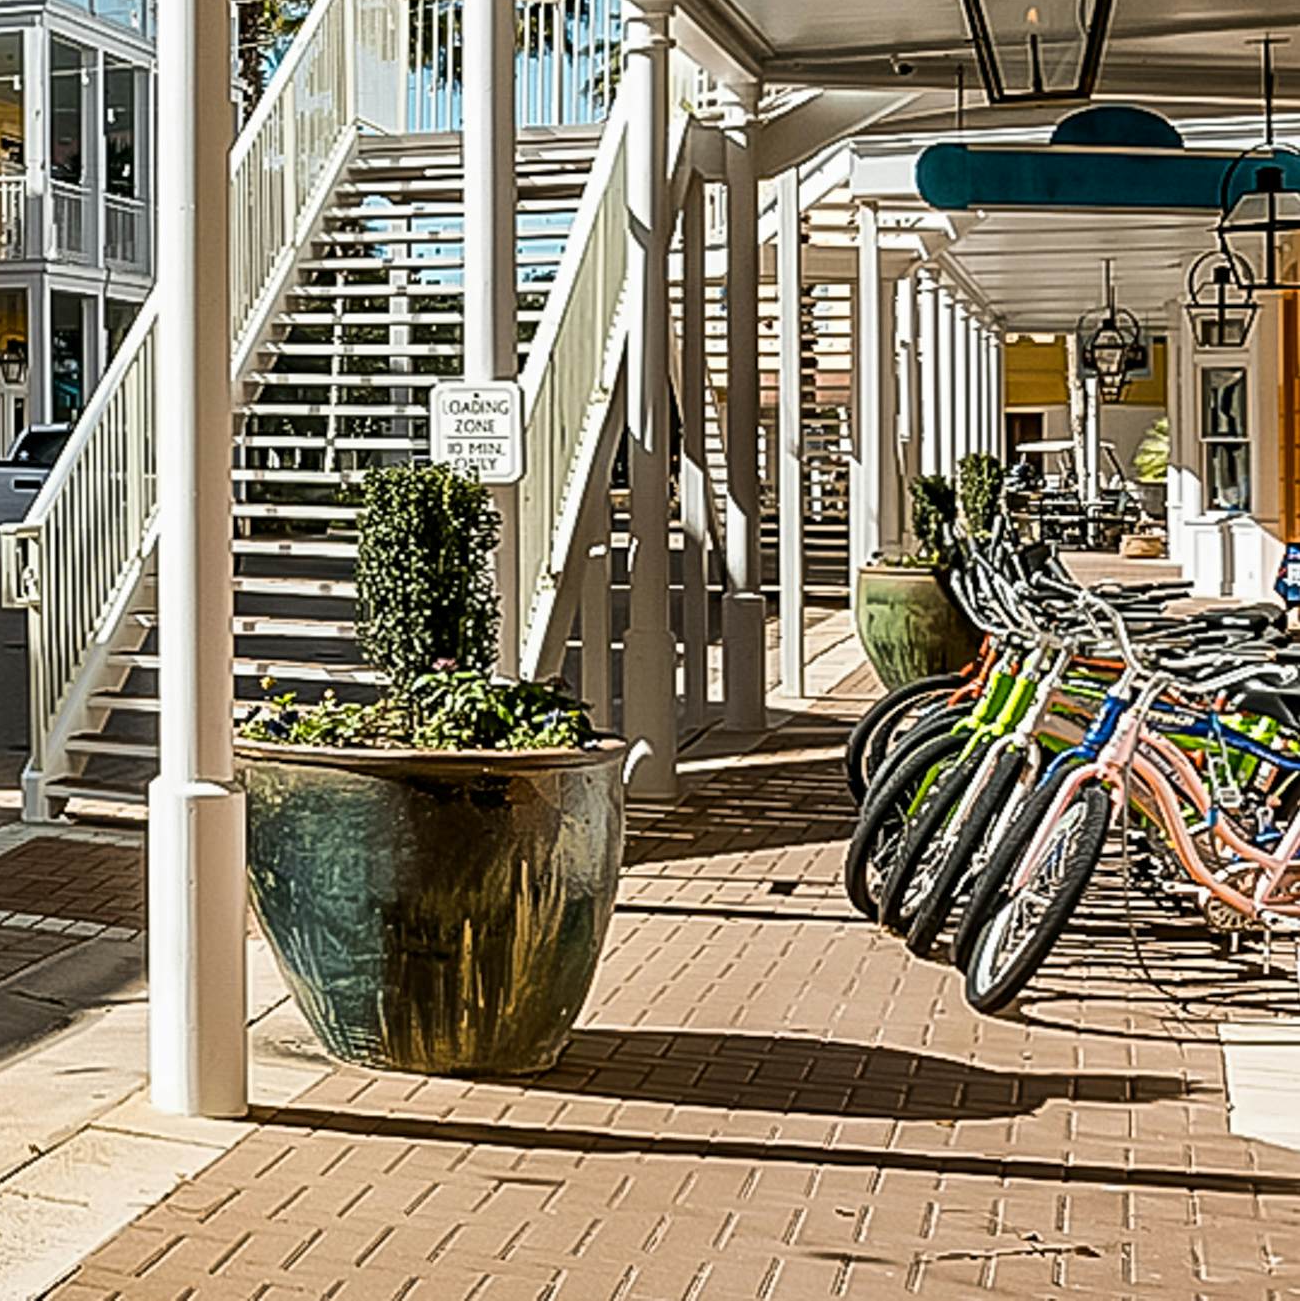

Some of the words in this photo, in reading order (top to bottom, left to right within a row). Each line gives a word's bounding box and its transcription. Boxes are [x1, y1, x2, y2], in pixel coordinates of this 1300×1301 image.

[442, 399, 509, 415] LOADING
[454, 419, 495, 434] ZONE
[447, 443, 463, 455] 10
